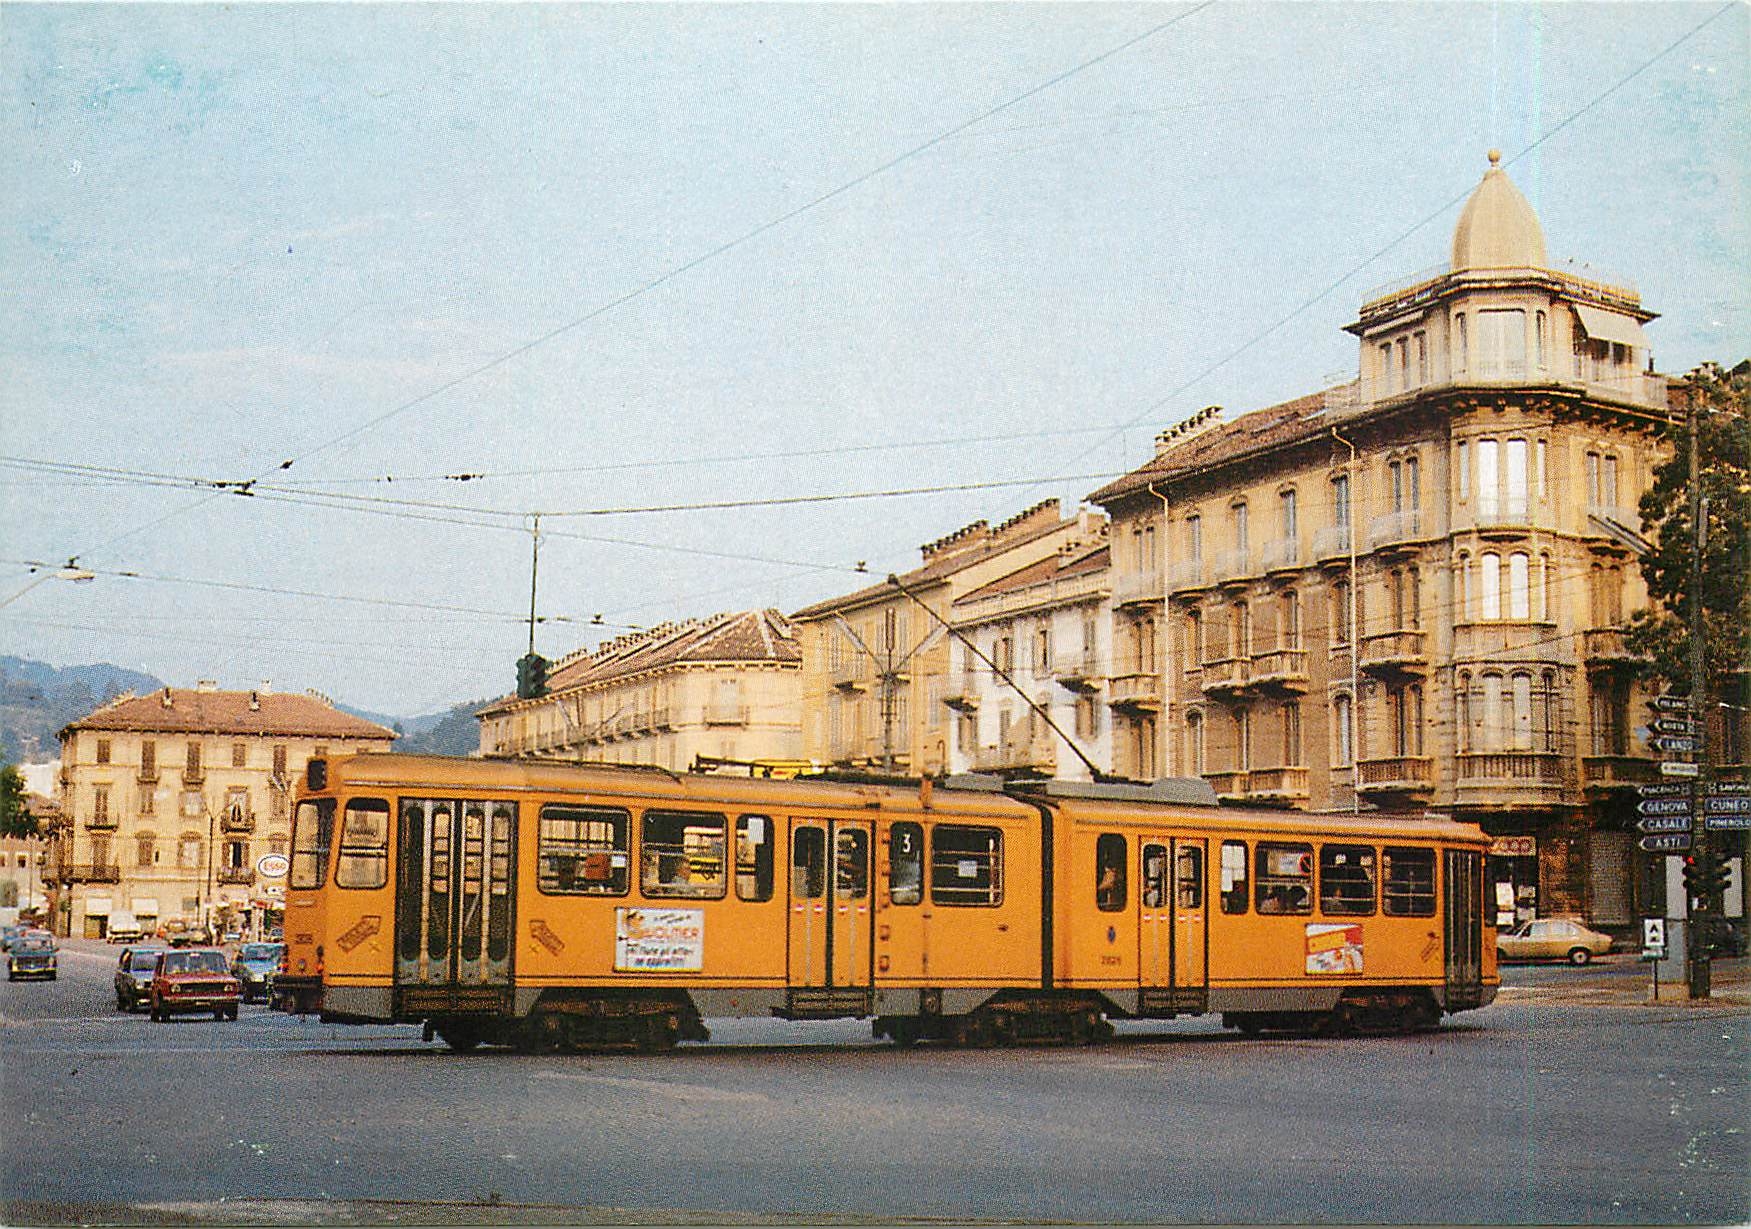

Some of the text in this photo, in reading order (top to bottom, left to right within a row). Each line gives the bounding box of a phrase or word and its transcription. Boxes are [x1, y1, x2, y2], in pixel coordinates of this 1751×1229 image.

[1647, 801, 1688, 813] GENOVA
[1711, 801, 1749, 812] CUNEO
[1648, 818, 1689, 829] CASALE
[902, 833, 911, 853] 3
[1656, 838, 1681, 849] ASTI
